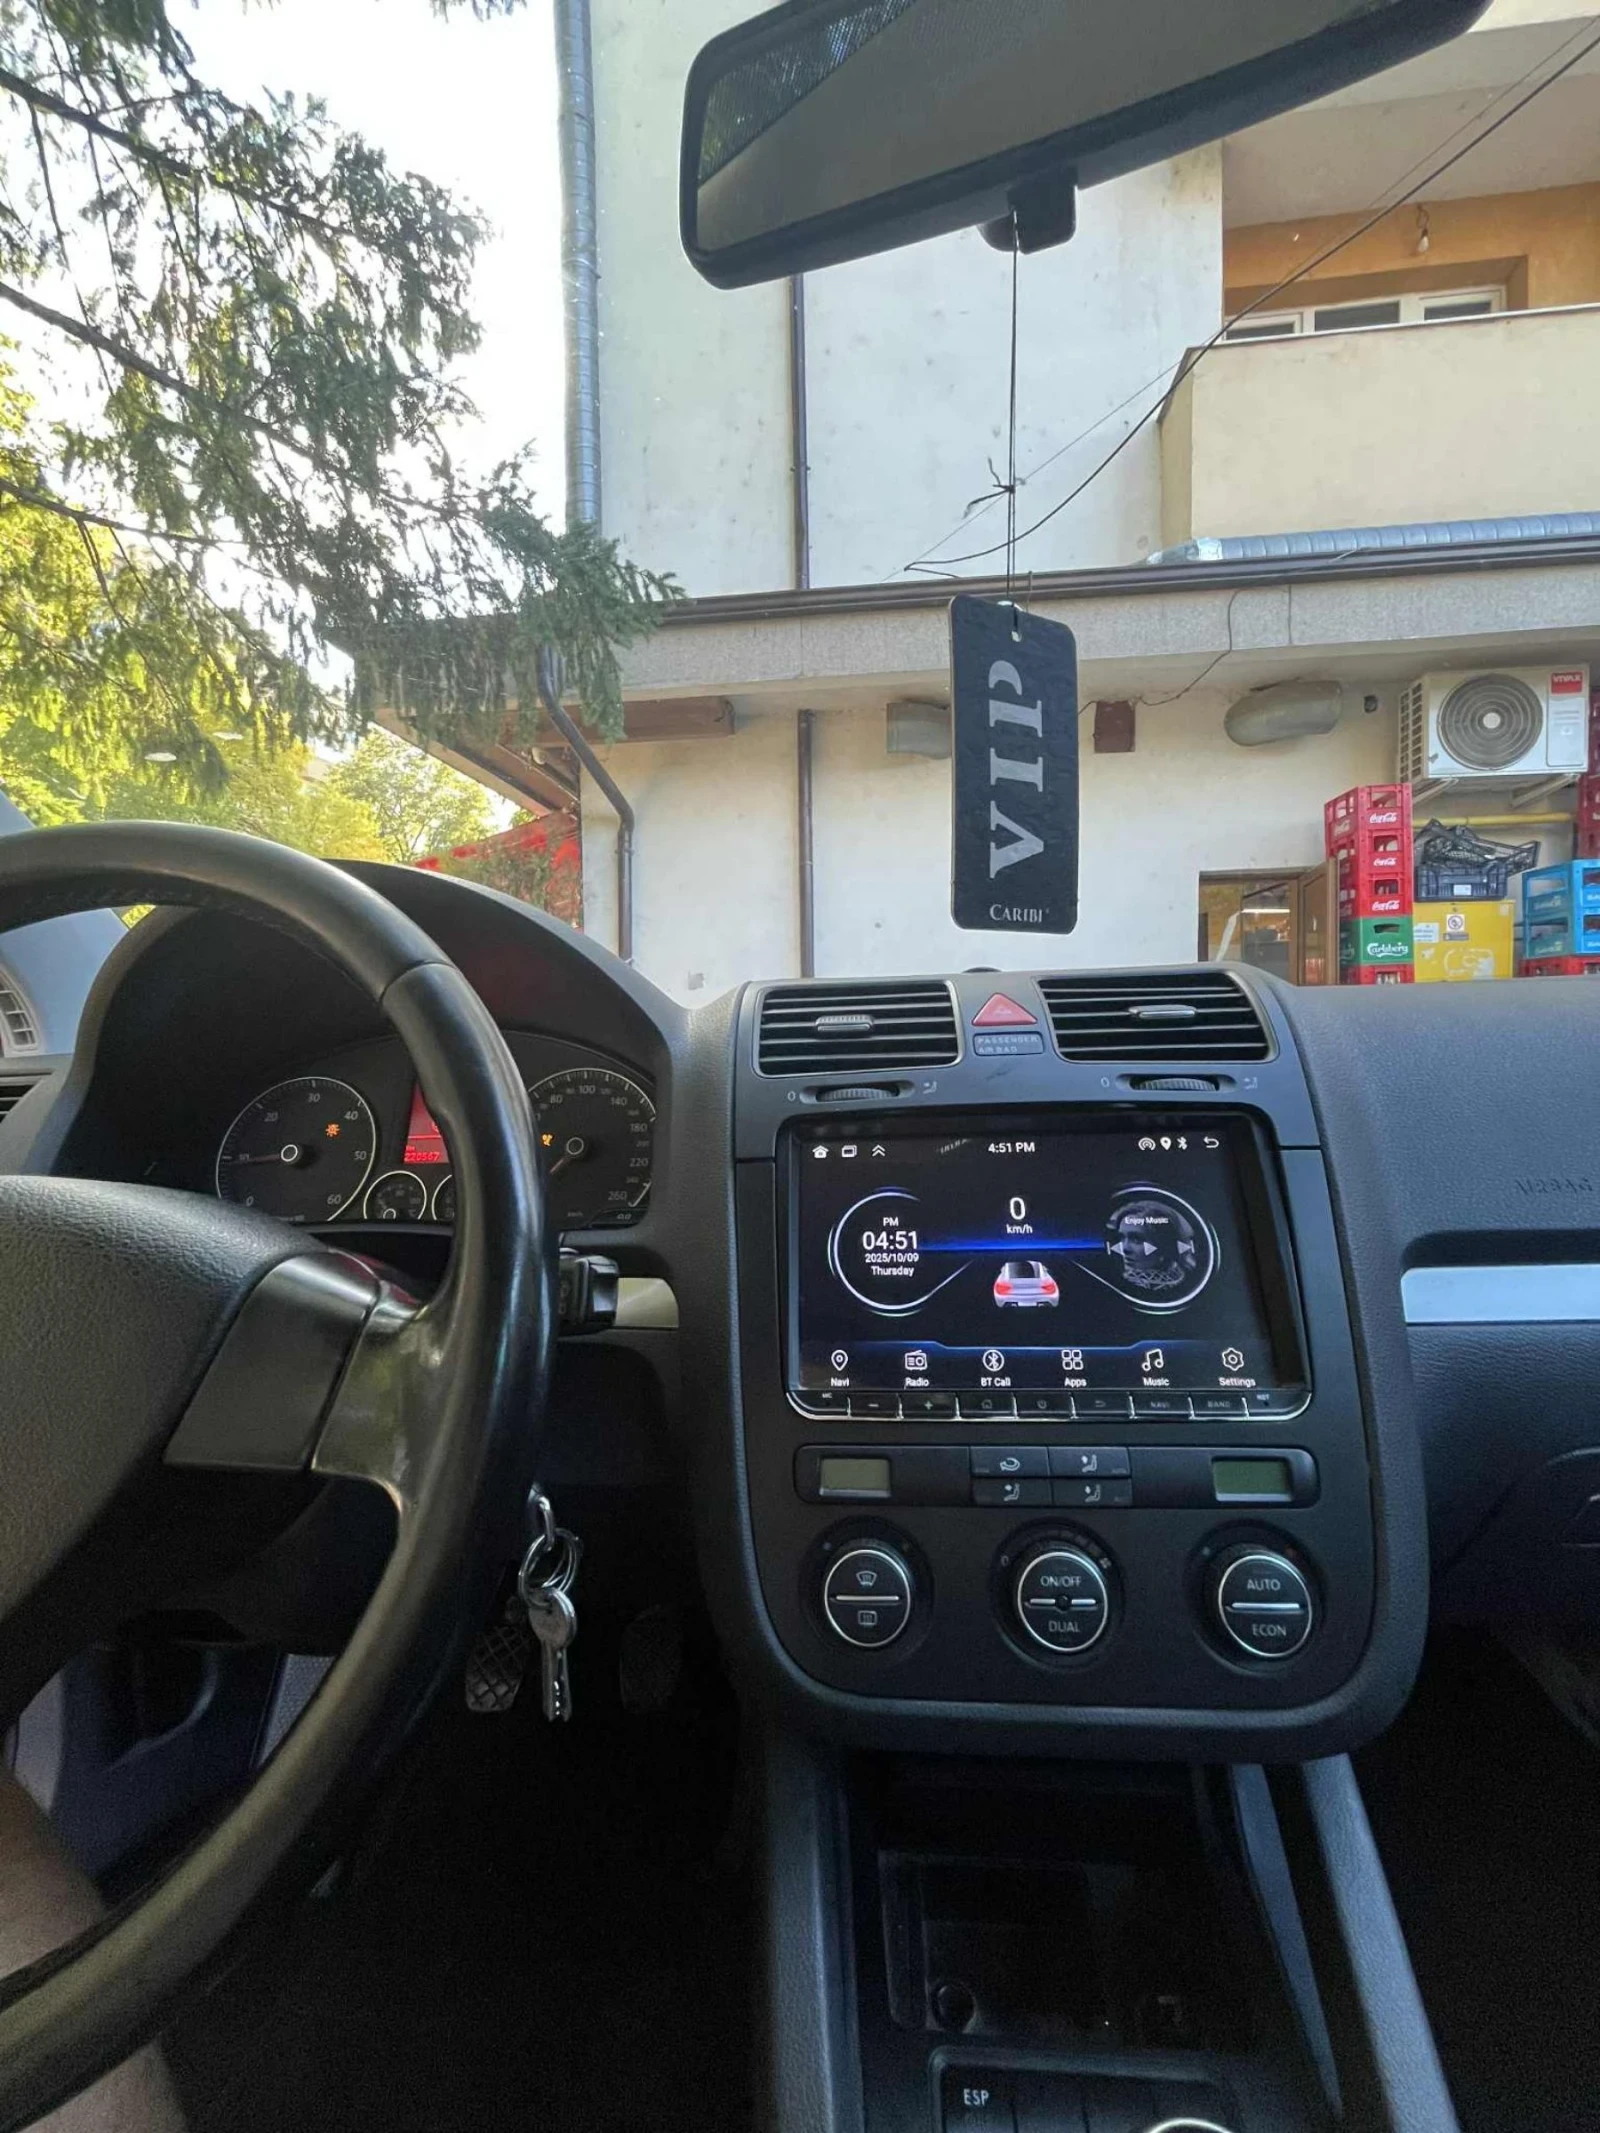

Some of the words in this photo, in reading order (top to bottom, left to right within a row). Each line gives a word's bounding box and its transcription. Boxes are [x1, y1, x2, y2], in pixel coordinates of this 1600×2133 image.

[1366, 942, 1409, 957] Carlsberg
[987, 1142, 1012, 1154] 4:51
[1015, 1142, 1036, 1153] PM
[1008, 1196, 1026, 1220] 0
[883, 1217, 899, 1227] PM
[1124, 1216, 1145, 1225] Enjoy
[1145, 1216, 1169, 1224] Music
[1006, 1223, 1033, 1235] km/h
[862, 1230, 918, 1250] 04:51
[865, 1252, 919, 1264] 2025/10/09
[871, 1265, 914, 1277] Thursday
[830, 1377, 850, 1387] Navi
[905, 1376, 930, 1387] Radio
[980, 1377, 992, 1387] BT
[994, 1376, 1011, 1387] Call
[1064, 1377, 1087, 1388] Apps
[1142, 1376, 1170, 1387] Music
[1218, 1376, 1256, 1388] Settings
[1040, 1575, 1082, 1588] ON/OFF
[1246, 1578, 1281, 1592] AUTO
[1048, 1620, 1081, 1633] DUAL
[1252, 1623, 1287, 1638] ECON
[962, 2087, 990, 2106] ESP
